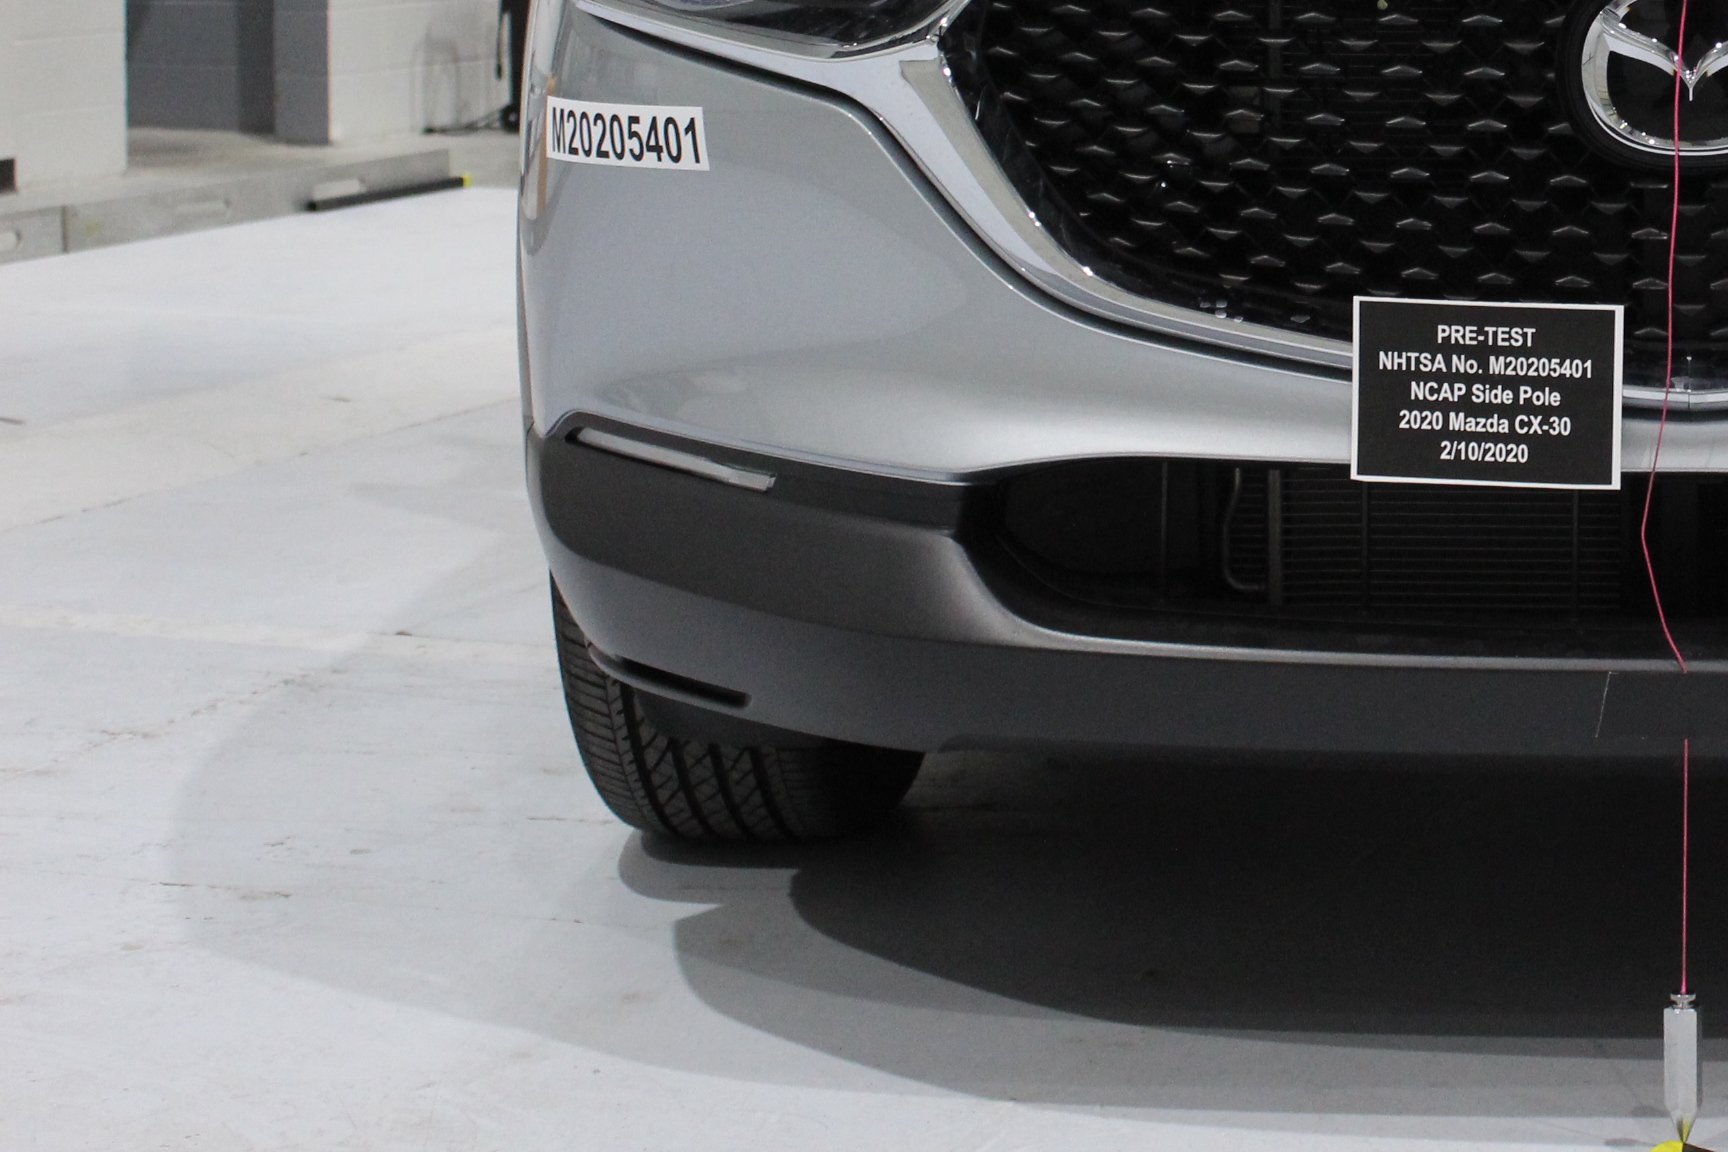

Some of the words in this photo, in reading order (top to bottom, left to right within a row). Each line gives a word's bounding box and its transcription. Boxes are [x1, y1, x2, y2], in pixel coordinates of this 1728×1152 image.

[552, 106, 701, 164] M20205401
[1437, 324, 1536, 347] PRE-TEST
[1378, 351, 1448, 373] NHTSA
[1451, 354, 1483, 374] No.
[1489, 355, 1592, 379] M20205401
[1410, 381, 1467, 402] NCAP
[1471, 383, 1514, 405] Side
[1519, 385, 1562, 407] Pole
[1399, 409, 1443, 431] 2020
[1448, 411, 1509, 434] Mazda
[1514, 414, 1572, 436] CX-30
[1439, 440, 1529, 464] 2/10/2020
